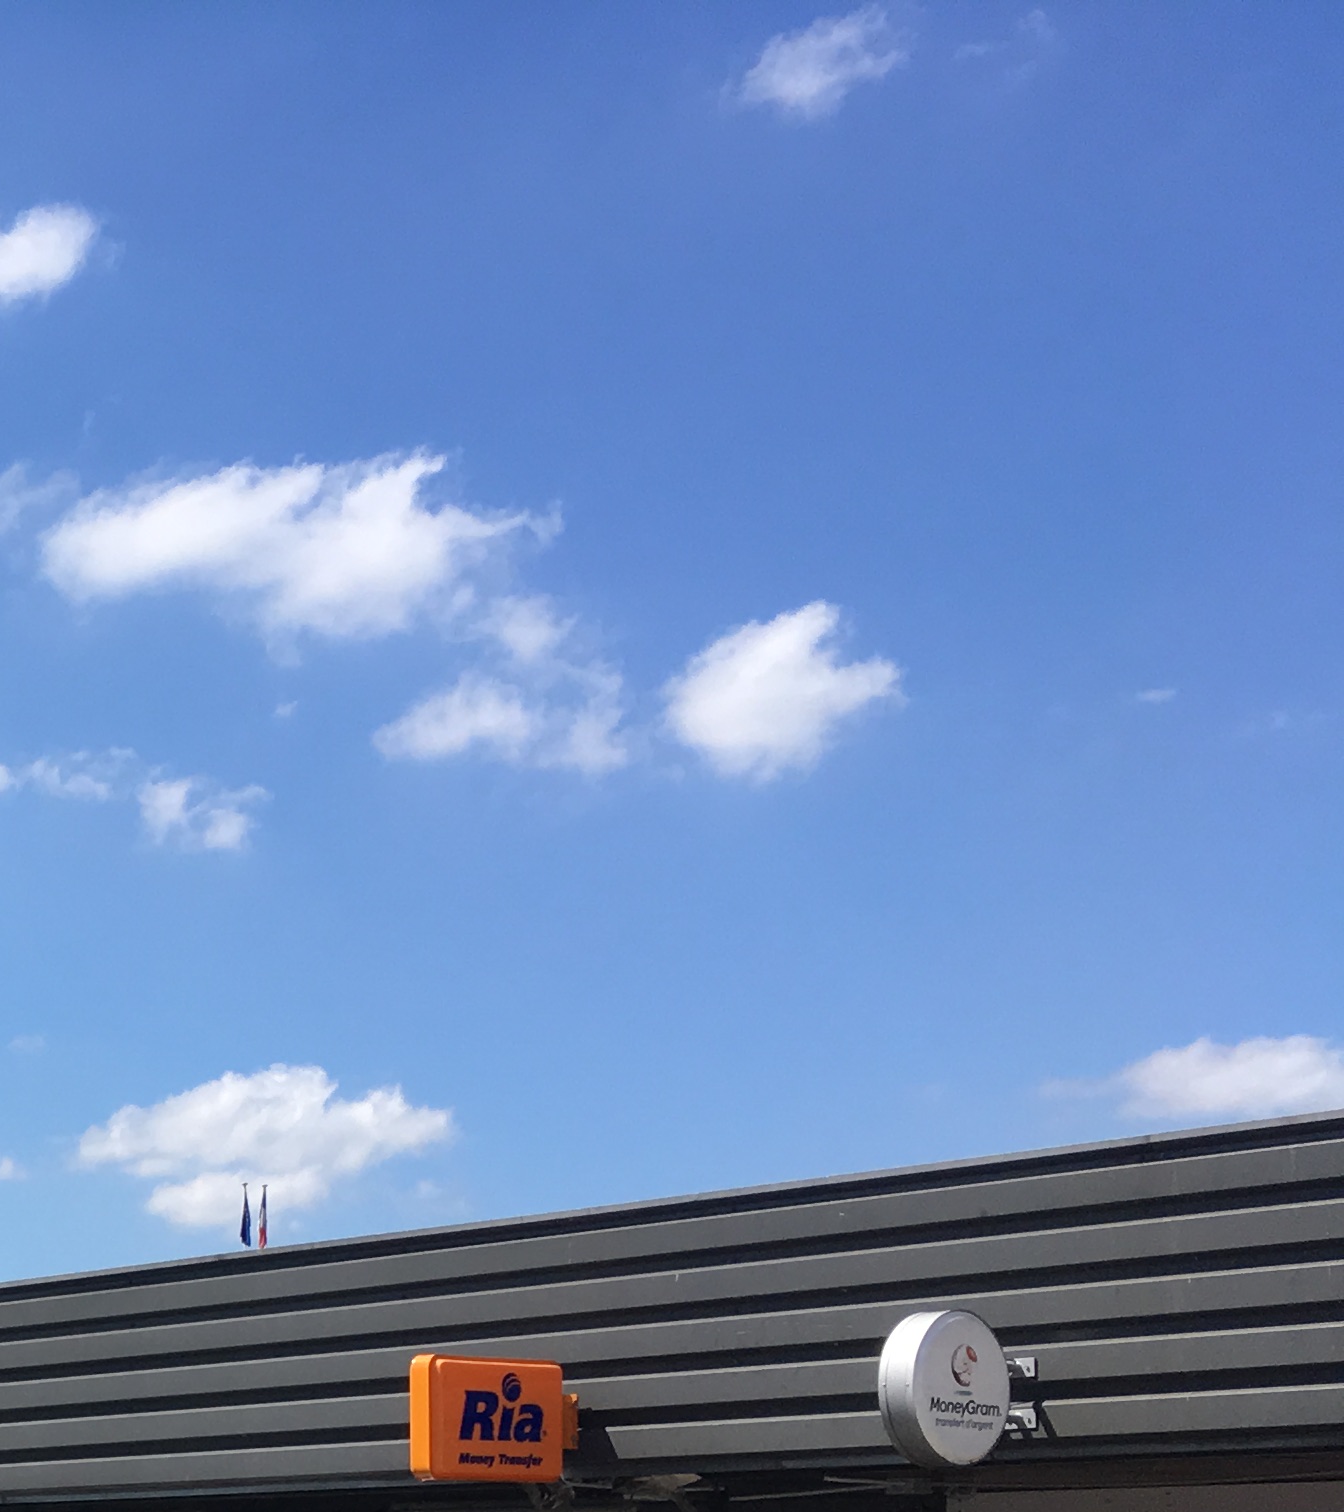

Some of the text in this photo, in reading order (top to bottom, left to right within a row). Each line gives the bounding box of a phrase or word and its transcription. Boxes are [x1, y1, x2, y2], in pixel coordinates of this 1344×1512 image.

[457, 1372, 543, 1442] Ria
[929, 1396, 1001, 1418] MoneyGram
[458, 1452, 544, 1468] Money Transfer
